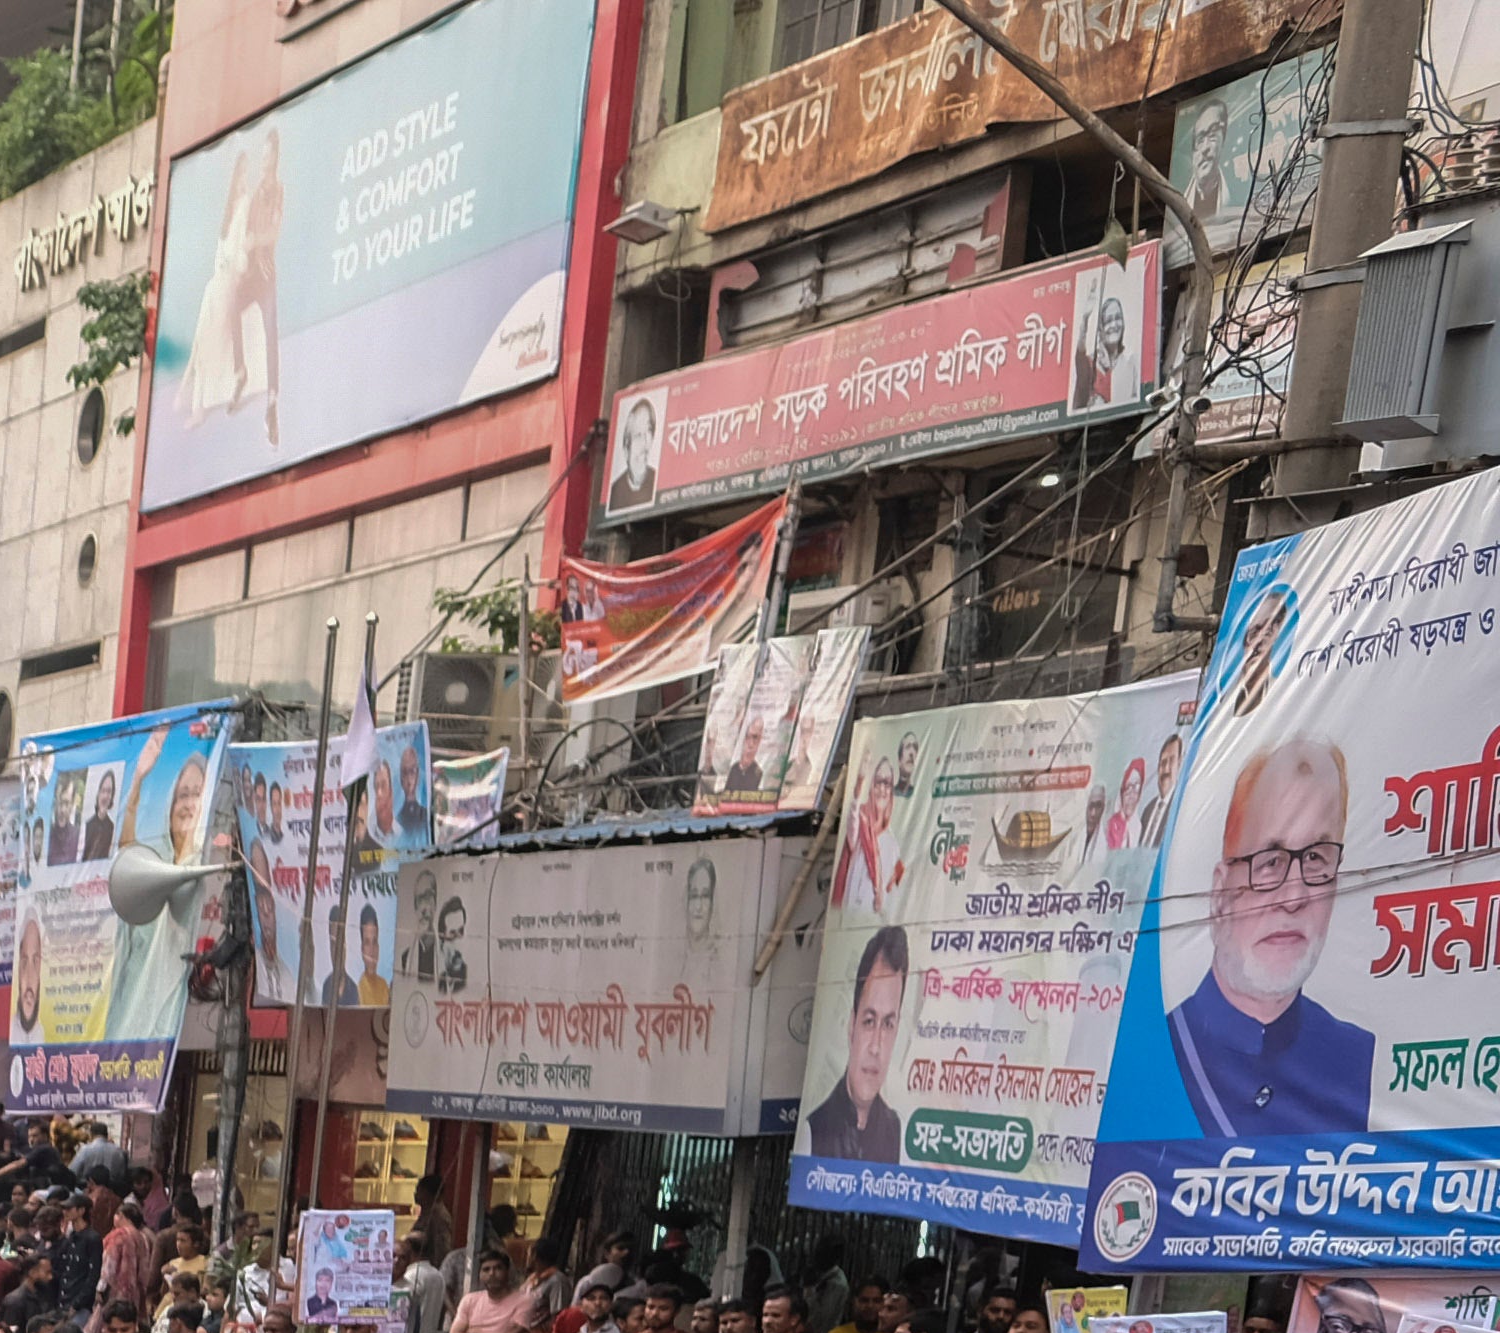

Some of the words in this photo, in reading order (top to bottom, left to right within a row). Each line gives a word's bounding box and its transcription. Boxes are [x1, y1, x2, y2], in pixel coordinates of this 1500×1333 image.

[339, 141, 388, 183] ADD
[393, 92, 460, 158] STYLE
[739, 75, 838, 167] ফটো
[335, 203, 353, 236] &
[355, 142, 464, 227] COMFORT
[331, 243, 359, 285] TO
[360, 215, 424, 274] YOUR
[426, 189, 478, 246] LIFE
[667, 397, 764, 458] বাংলাদেশ
[772, 382, 828, 434] সড়ক
[837, 358, 930, 413] পরিবহণ
[934, 329, 1010, 388] শ্রমিক
[1016, 312, 1069, 371] লীগ
[1236, 562, 1258, 583] জয়
[1402, 542, 1468, 600] বিরোধী
[1337, 620, 1404, 675] বিরোধী
[1408, 609, 1471, 666] ষড়যন্ত্র
[1477, 612, 1497, 638] ও
[965, 881, 1025, 917] জাতীয়
[1026, 883, 1084, 918] শ্রমিক
[1085, 878, 1126, 916] লীগ
[930, 929, 975, 952] ঢাকা
[977, 928, 1054, 954] মহানগর
[1057, 920, 1114, 954] দক্ষিণ
[922, 966, 1005, 1000] ত্রি-বার্ষিক
[434, 989, 531, 1051] বাংলাদেশ
[535, 982, 629, 1051] আওয়ামী
[634, 982, 716, 1064] যুবলীগ
[496, 1052, 539, 1089] কেন্দ্রীয়
[543, 1053, 593, 1091] কার্যালয়
[906, 1058, 936, 1093] মোঃ
[938, 1045, 994, 1099] মনিরুল
[993, 1053, 1045, 1103] ইসলাম
[1045, 1067, 1096, 1110] সোহেল
[1388, 1037, 1470, 1094] সফল
[912, 1119, 1028, 1164] সহ-সভাপতি
[1036, 1132, 1062, 1162] পদে
[1170, 1145, 1292, 1223] কবির
[1295, 1142, 1429, 1217] উদ্দিন
[1161, 1236, 1211, 1259] সাবেক
[1212, 1225, 1285, 1260] সভাপতি,
[1287, 1229, 1327, 1259] কবি
[1326, 1234, 1397, 1260] নজরুল
[1396, 1228, 1468, 1259] সরকারি
